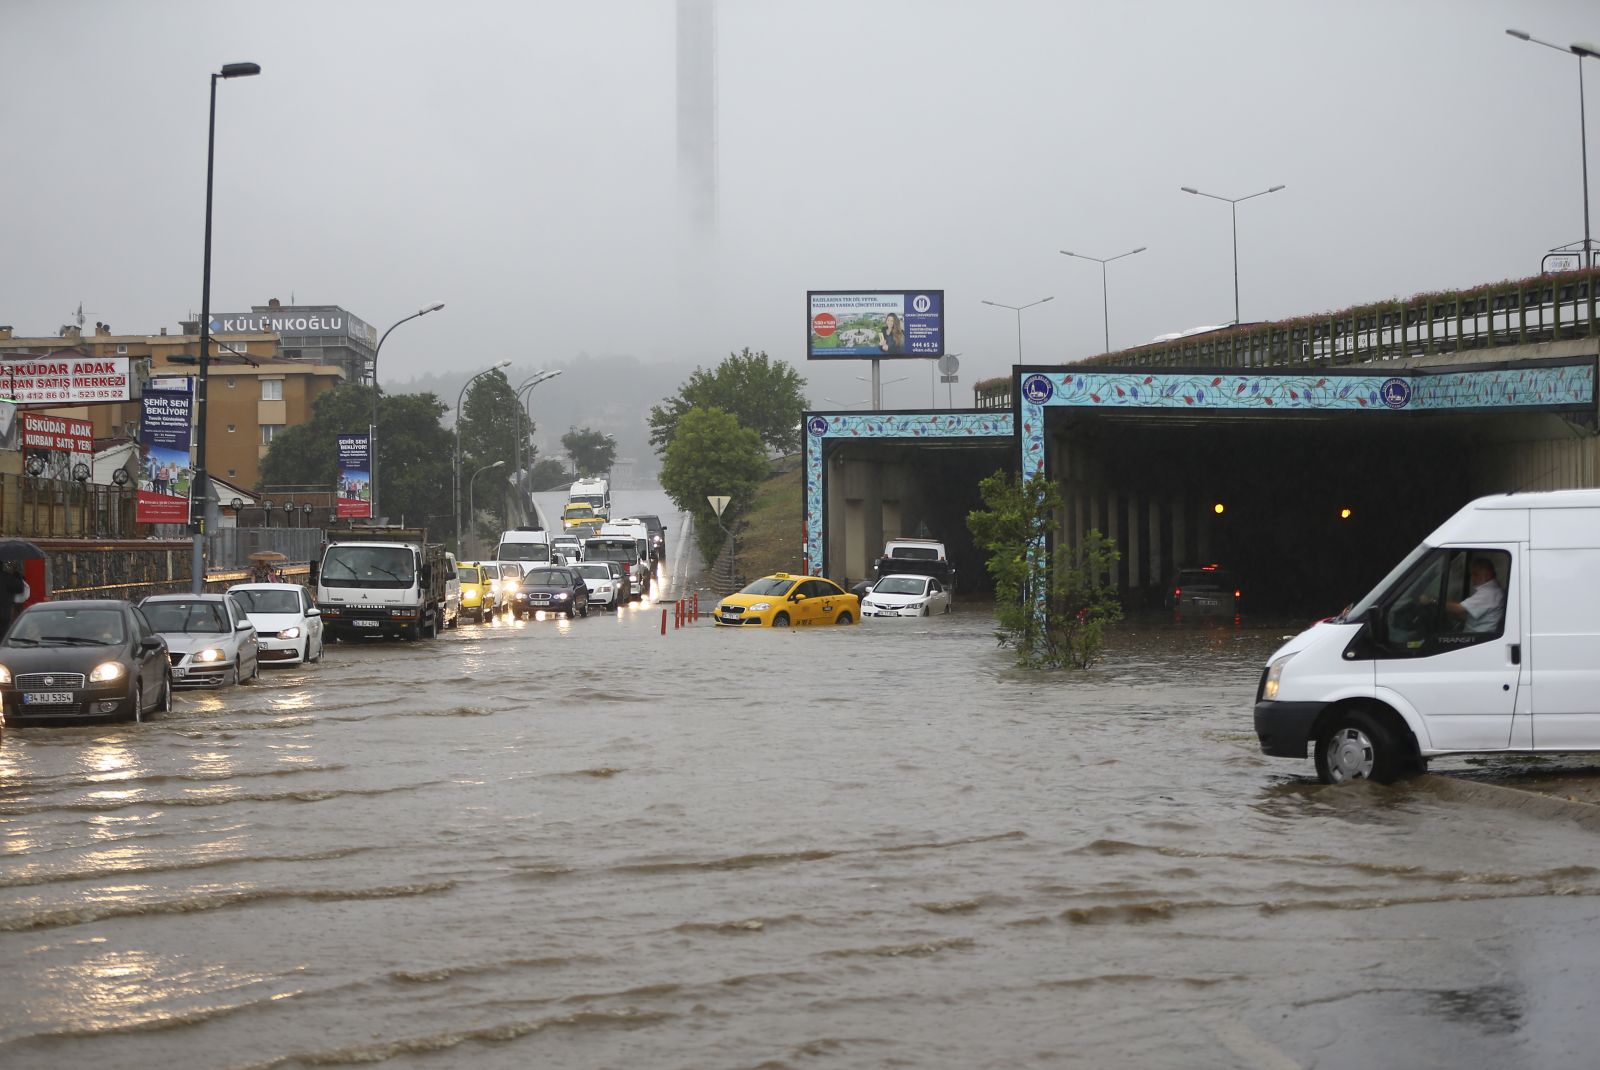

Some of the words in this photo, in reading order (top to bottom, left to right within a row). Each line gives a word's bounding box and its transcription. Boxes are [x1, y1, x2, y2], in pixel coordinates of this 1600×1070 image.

[224, 315, 342, 331] KÜLÜNKOĞLU
[74, 362, 115, 374] ADAK
[37, 378, 70, 391] SATIŞ
[74, 375, 126, 387] MERKEZİ
[144, 397, 168, 407] ŞEHİR
[170, 398, 189, 408] SENİ
[146, 407, 188, 416] BEKLİYOR!
[26, 415, 66, 434] ÜSKÜDAR
[70, 424, 91, 437] ADAK
[26, 434, 54, 447] KURBAN
[56, 437, 74, 450] SATIŞ
[77, 439, 92, 451] YERİ
[29, 693, 38, 702] 34
[40, 693, 50, 702] HJ
[52, 693, 71, 702] 5354
